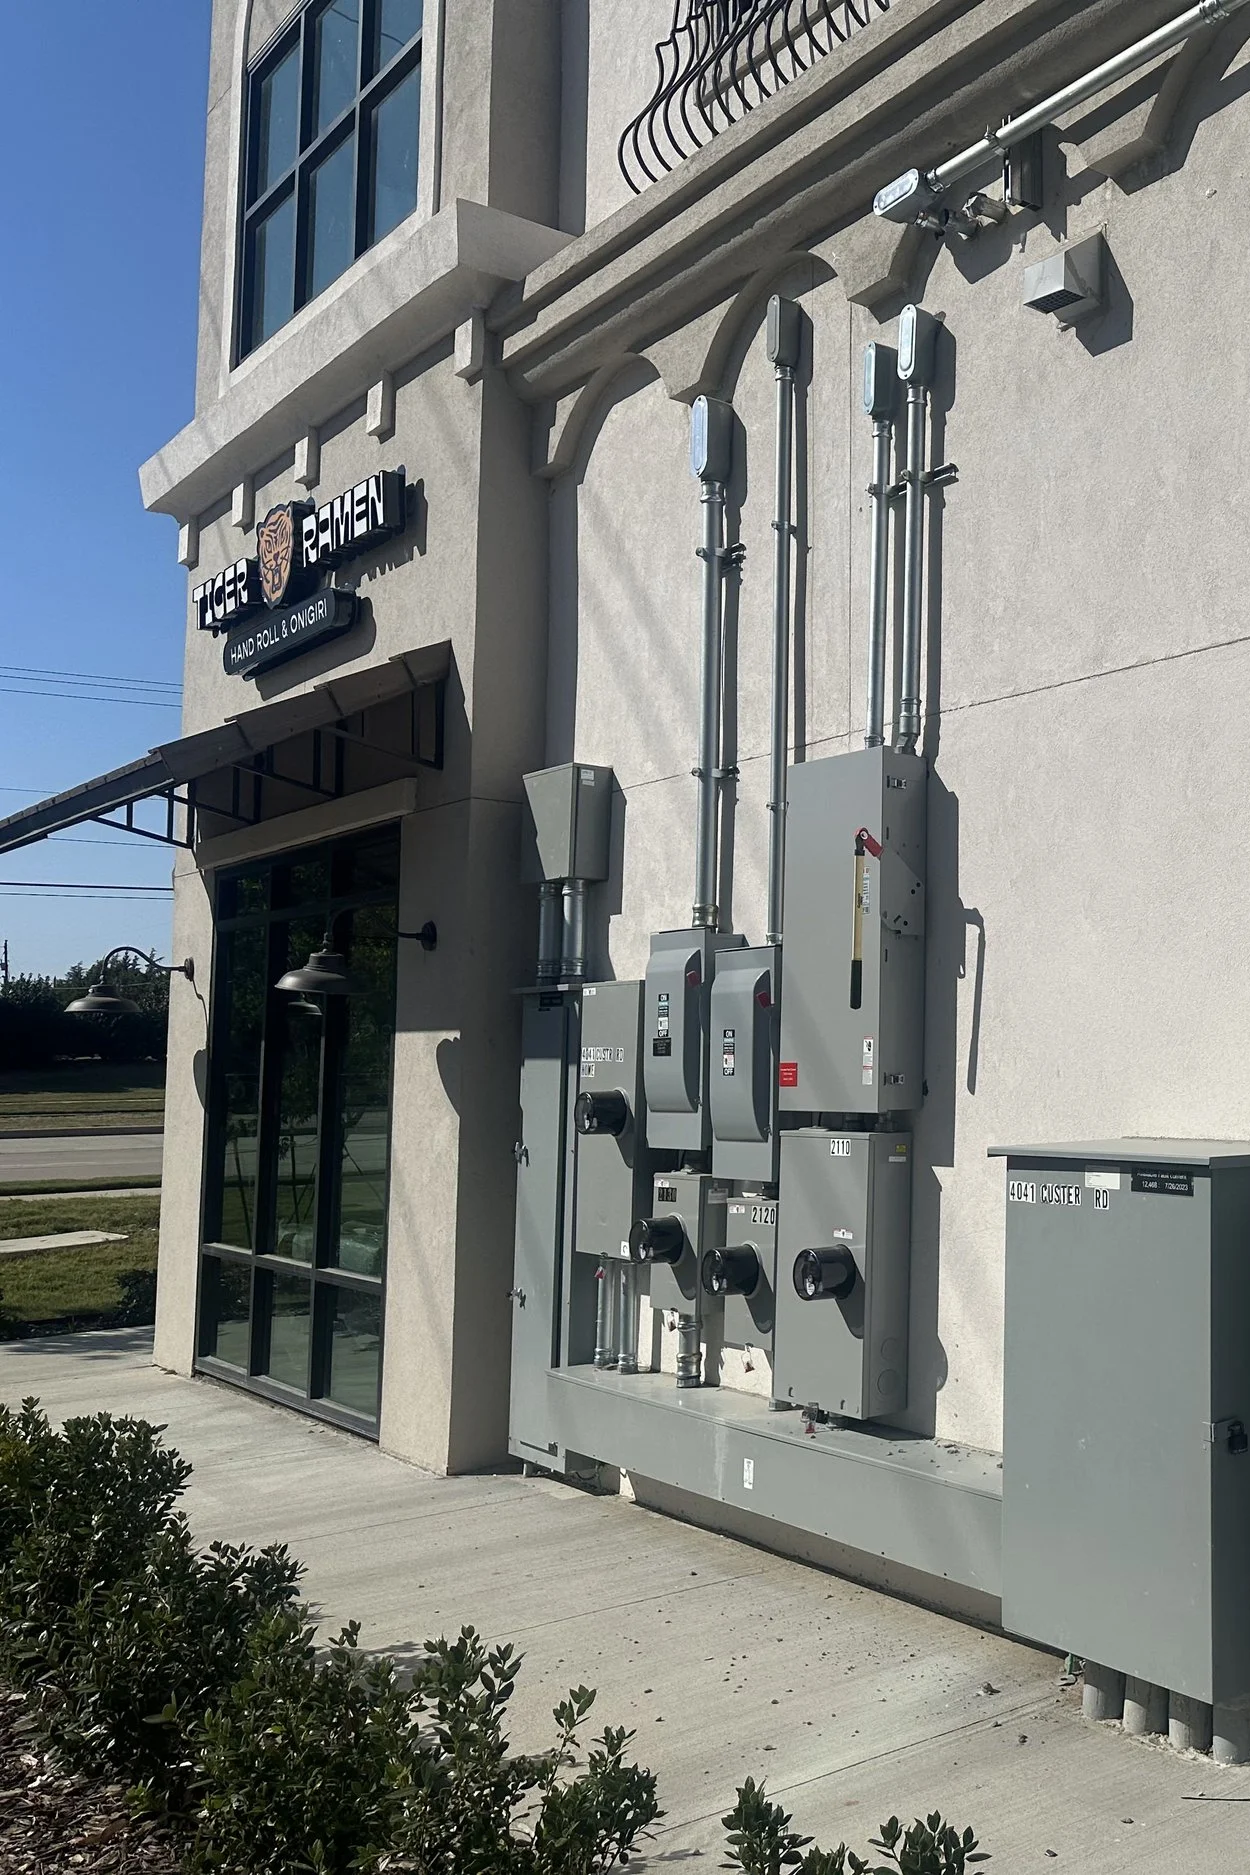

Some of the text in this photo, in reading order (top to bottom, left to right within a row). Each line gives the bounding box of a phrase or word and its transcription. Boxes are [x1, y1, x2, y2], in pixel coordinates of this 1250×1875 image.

[302, 470, 385, 568] RAMEN
[193, 558, 248, 630] TIGER
[230, 598, 328, 665] HAND ROLL & ONIGIRI
[831, 1140, 850, 1155] 2110
[752, 1206, 776, 1225] 2120
[1010, 1182, 1108, 1209] 4041 CUSTER RD
